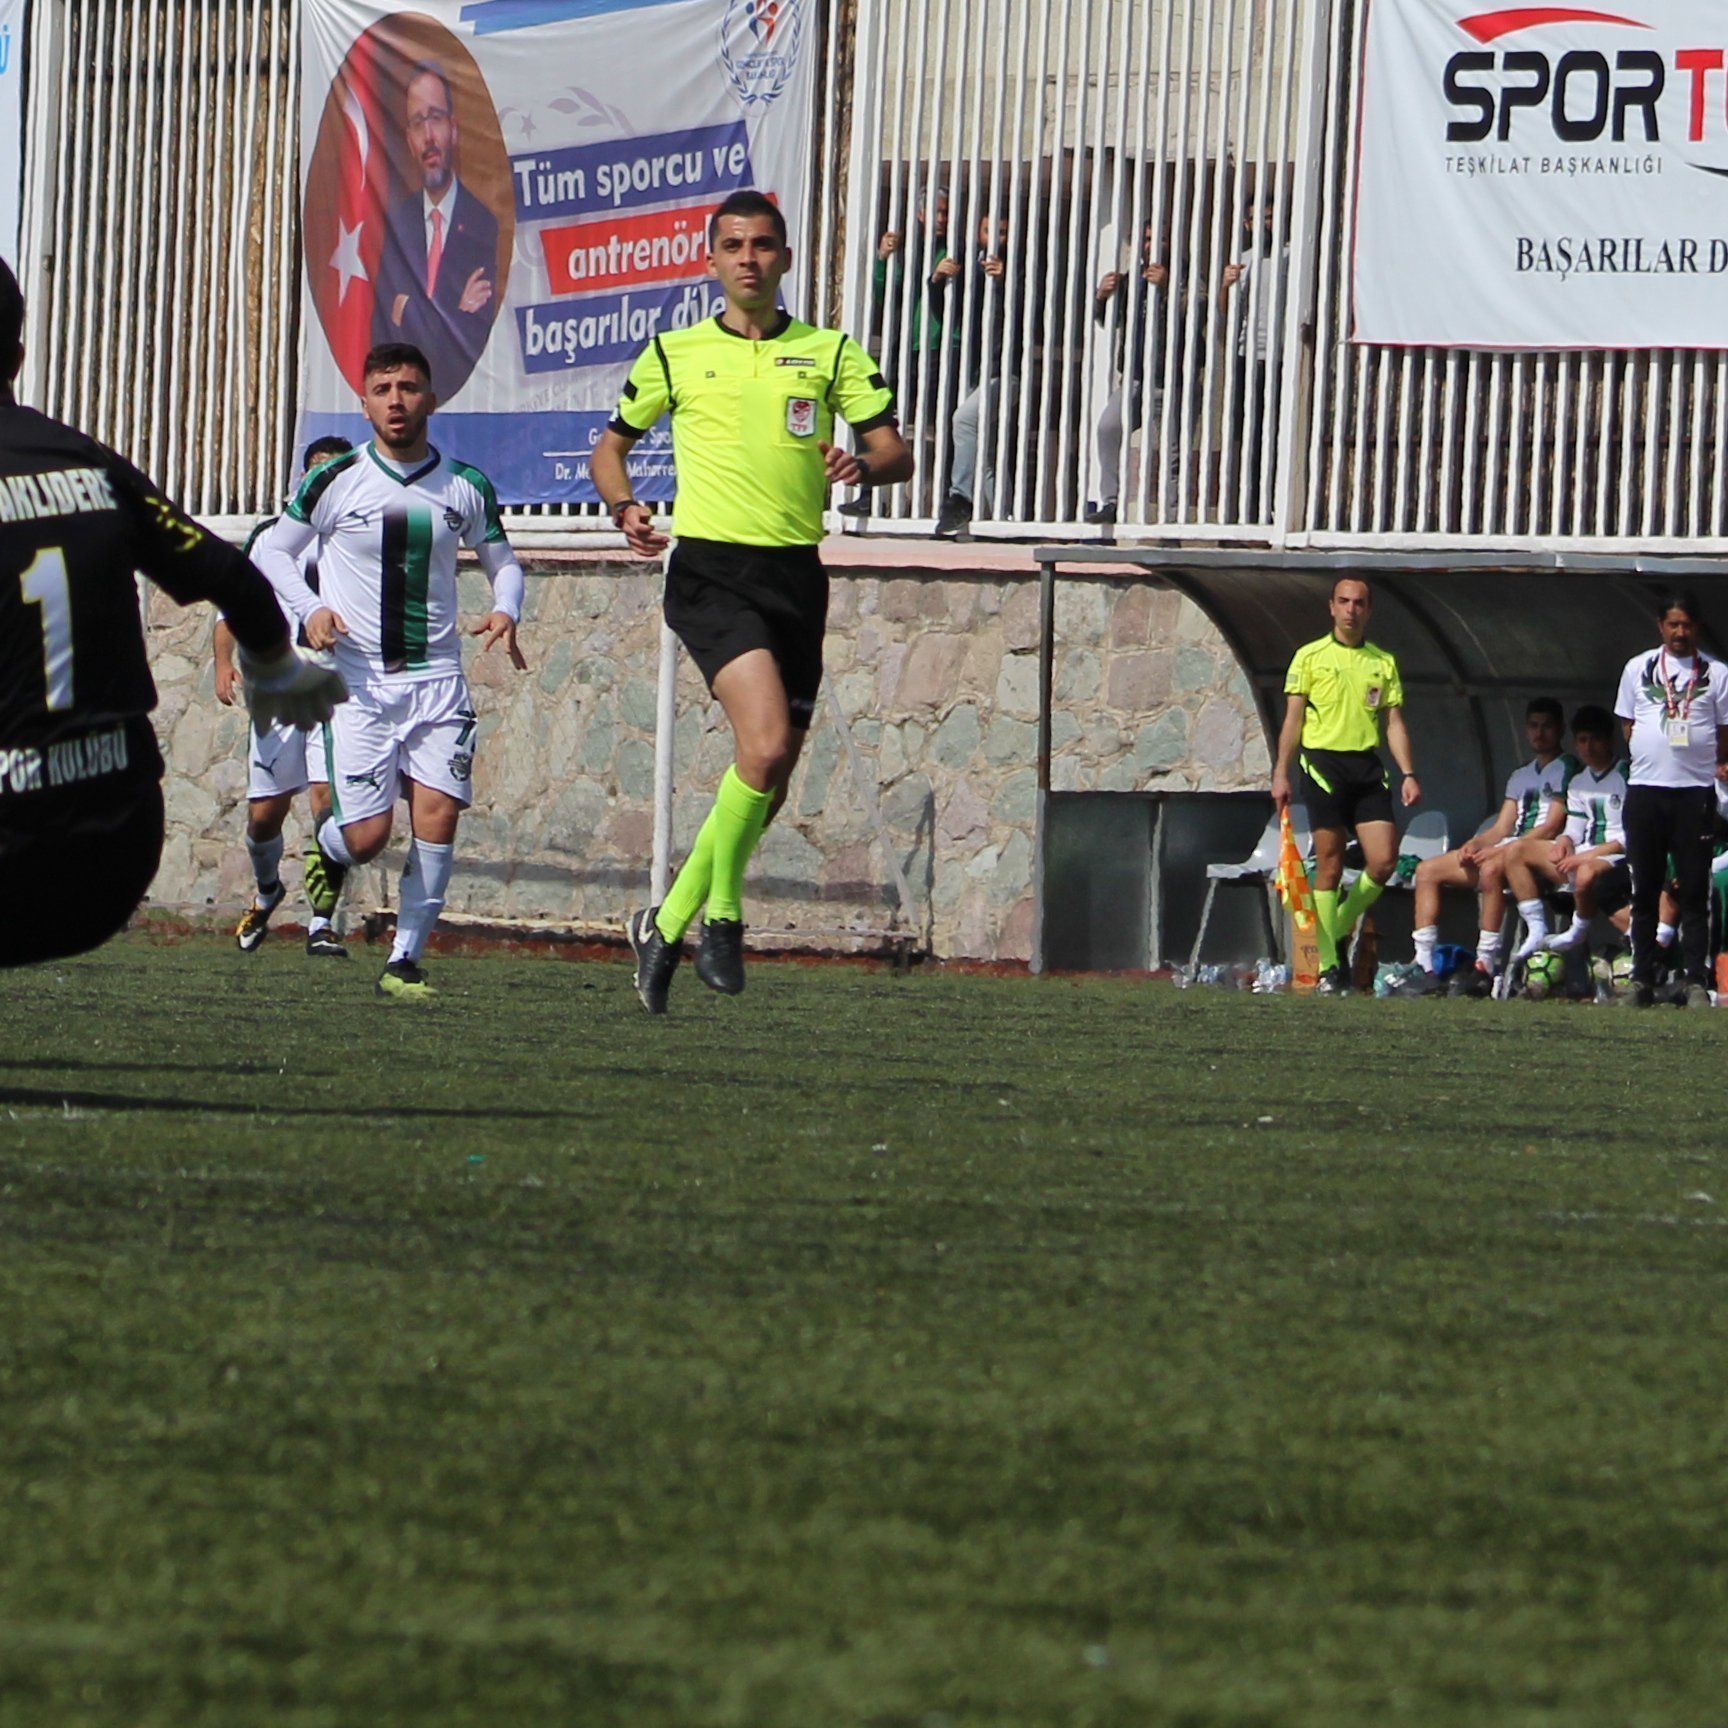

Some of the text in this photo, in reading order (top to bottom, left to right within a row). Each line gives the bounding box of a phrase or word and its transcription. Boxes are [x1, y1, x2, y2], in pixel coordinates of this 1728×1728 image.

[512, 142, 747, 209] Tüm sporcu ve
[1444, 152, 1664, 176] TEŞKİLAT BAŞKANLIĞI
[1515, 236, 1698, 281] BAŞARILAR
[524, 294, 662, 364] başarılar
[19, 546, 74, 712] 1
